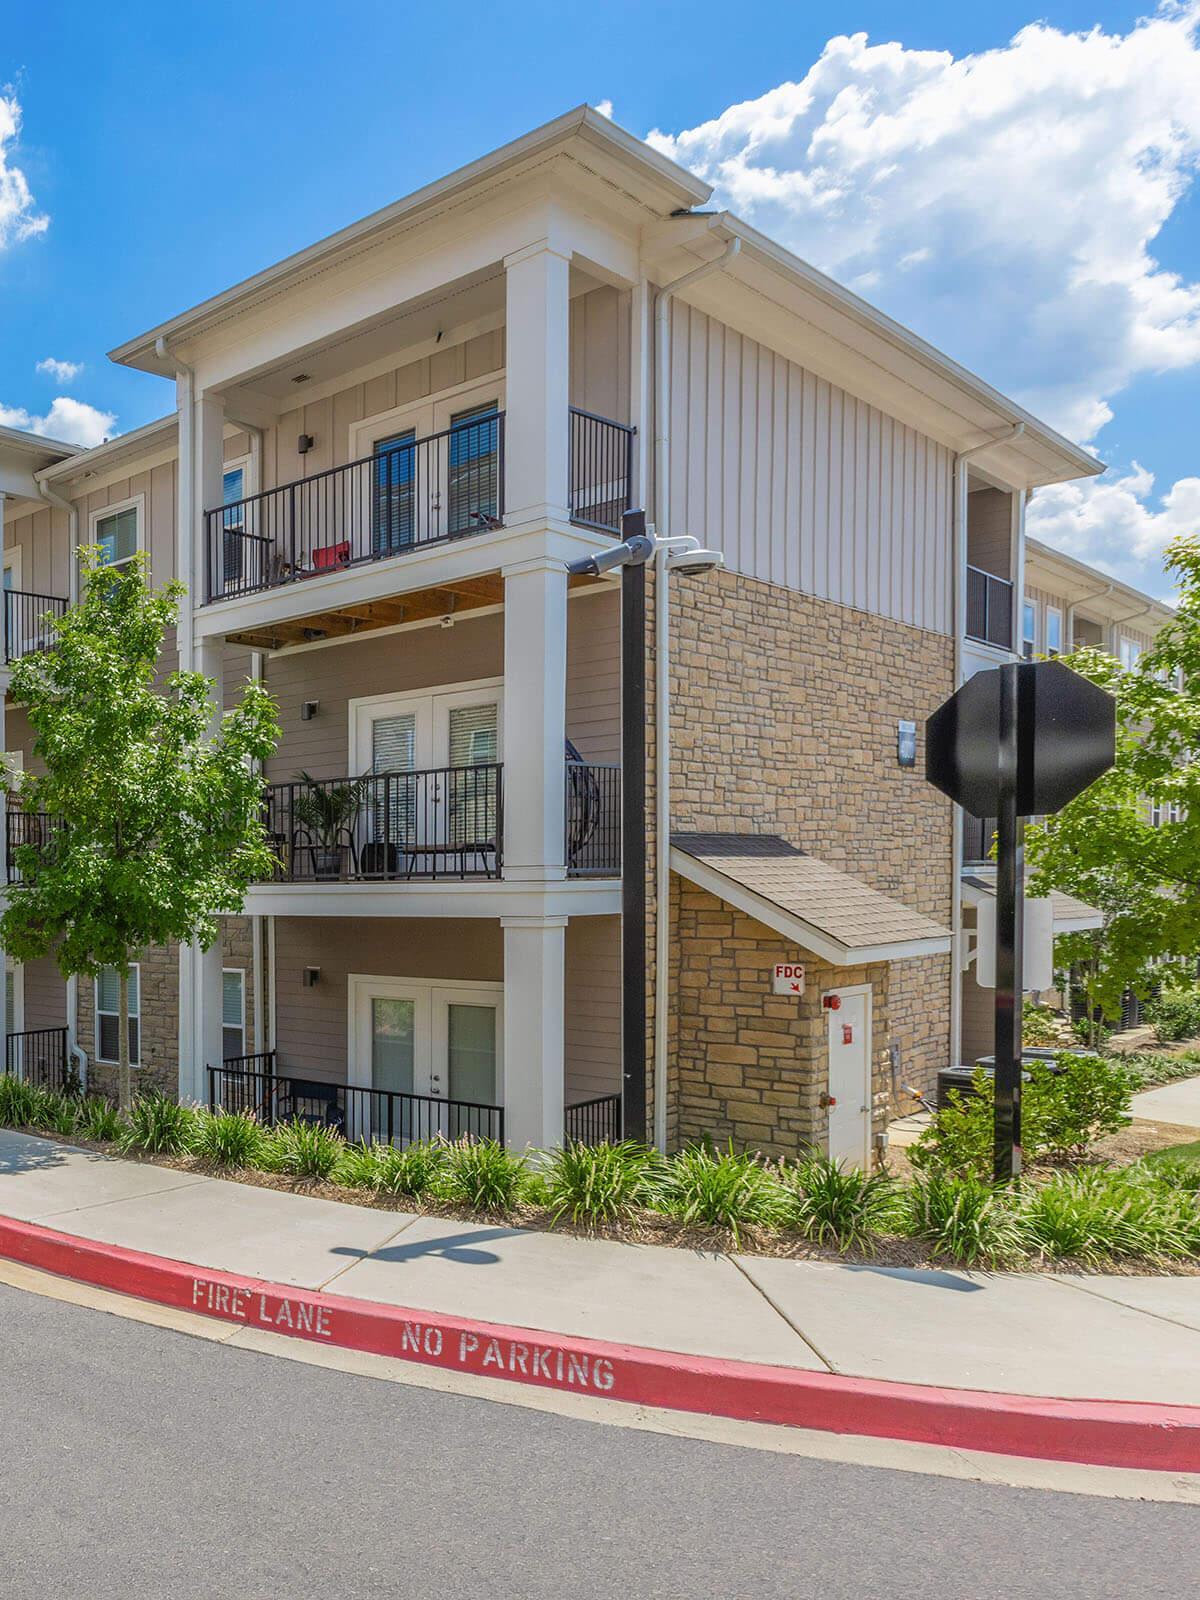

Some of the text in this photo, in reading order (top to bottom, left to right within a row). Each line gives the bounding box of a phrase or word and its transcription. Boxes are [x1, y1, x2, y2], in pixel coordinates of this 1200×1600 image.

[776, 966, 802, 979] FDC
[192, 1279, 615, 1390] FIRE LANE NO PARKING
